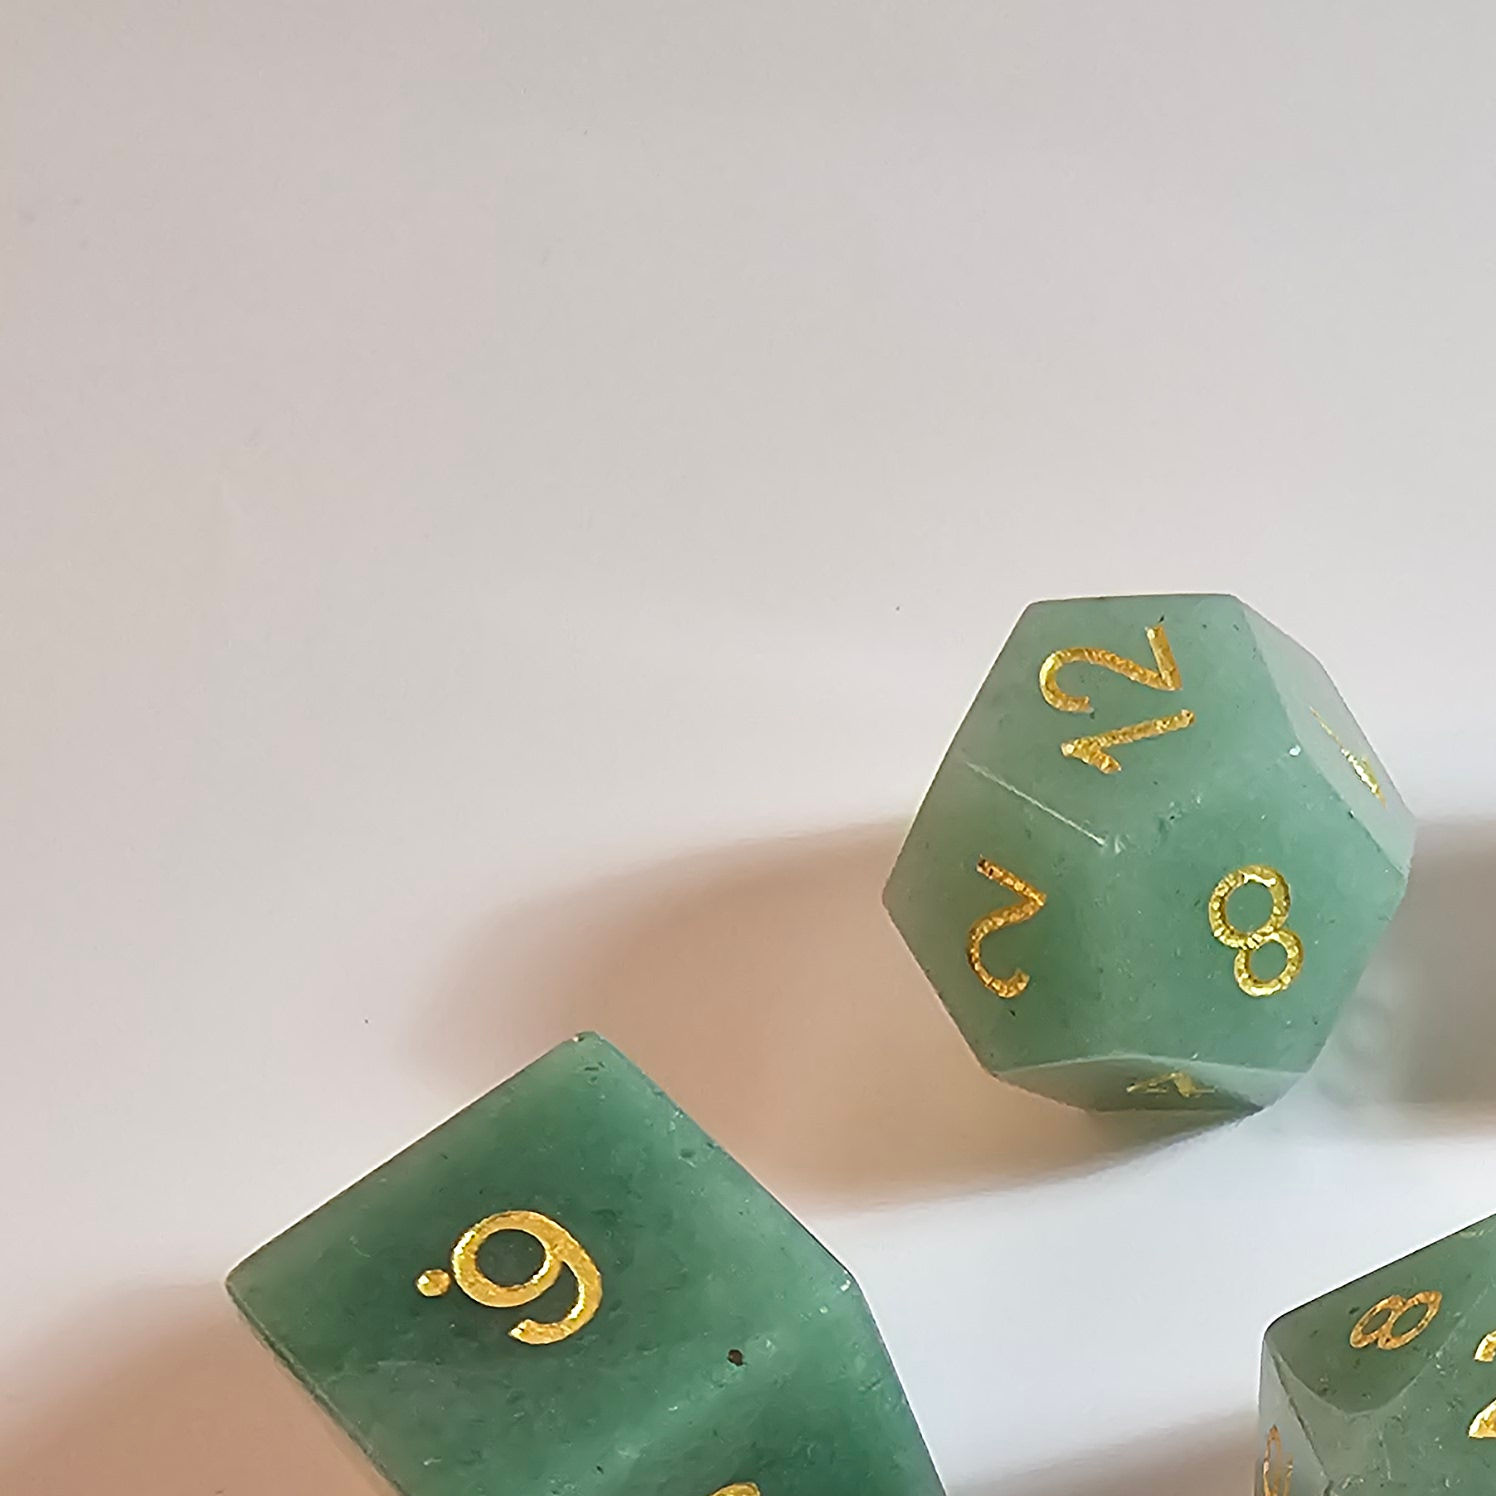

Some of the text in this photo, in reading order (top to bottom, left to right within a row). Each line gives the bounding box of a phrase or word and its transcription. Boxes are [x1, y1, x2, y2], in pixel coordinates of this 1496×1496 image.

[1038, 624, 1196, 774] 12
[966, 856, 1047, 998] 2
[1208, 865, 1304, 996] 8
[1350, 1290, 1442, 1350] 8
